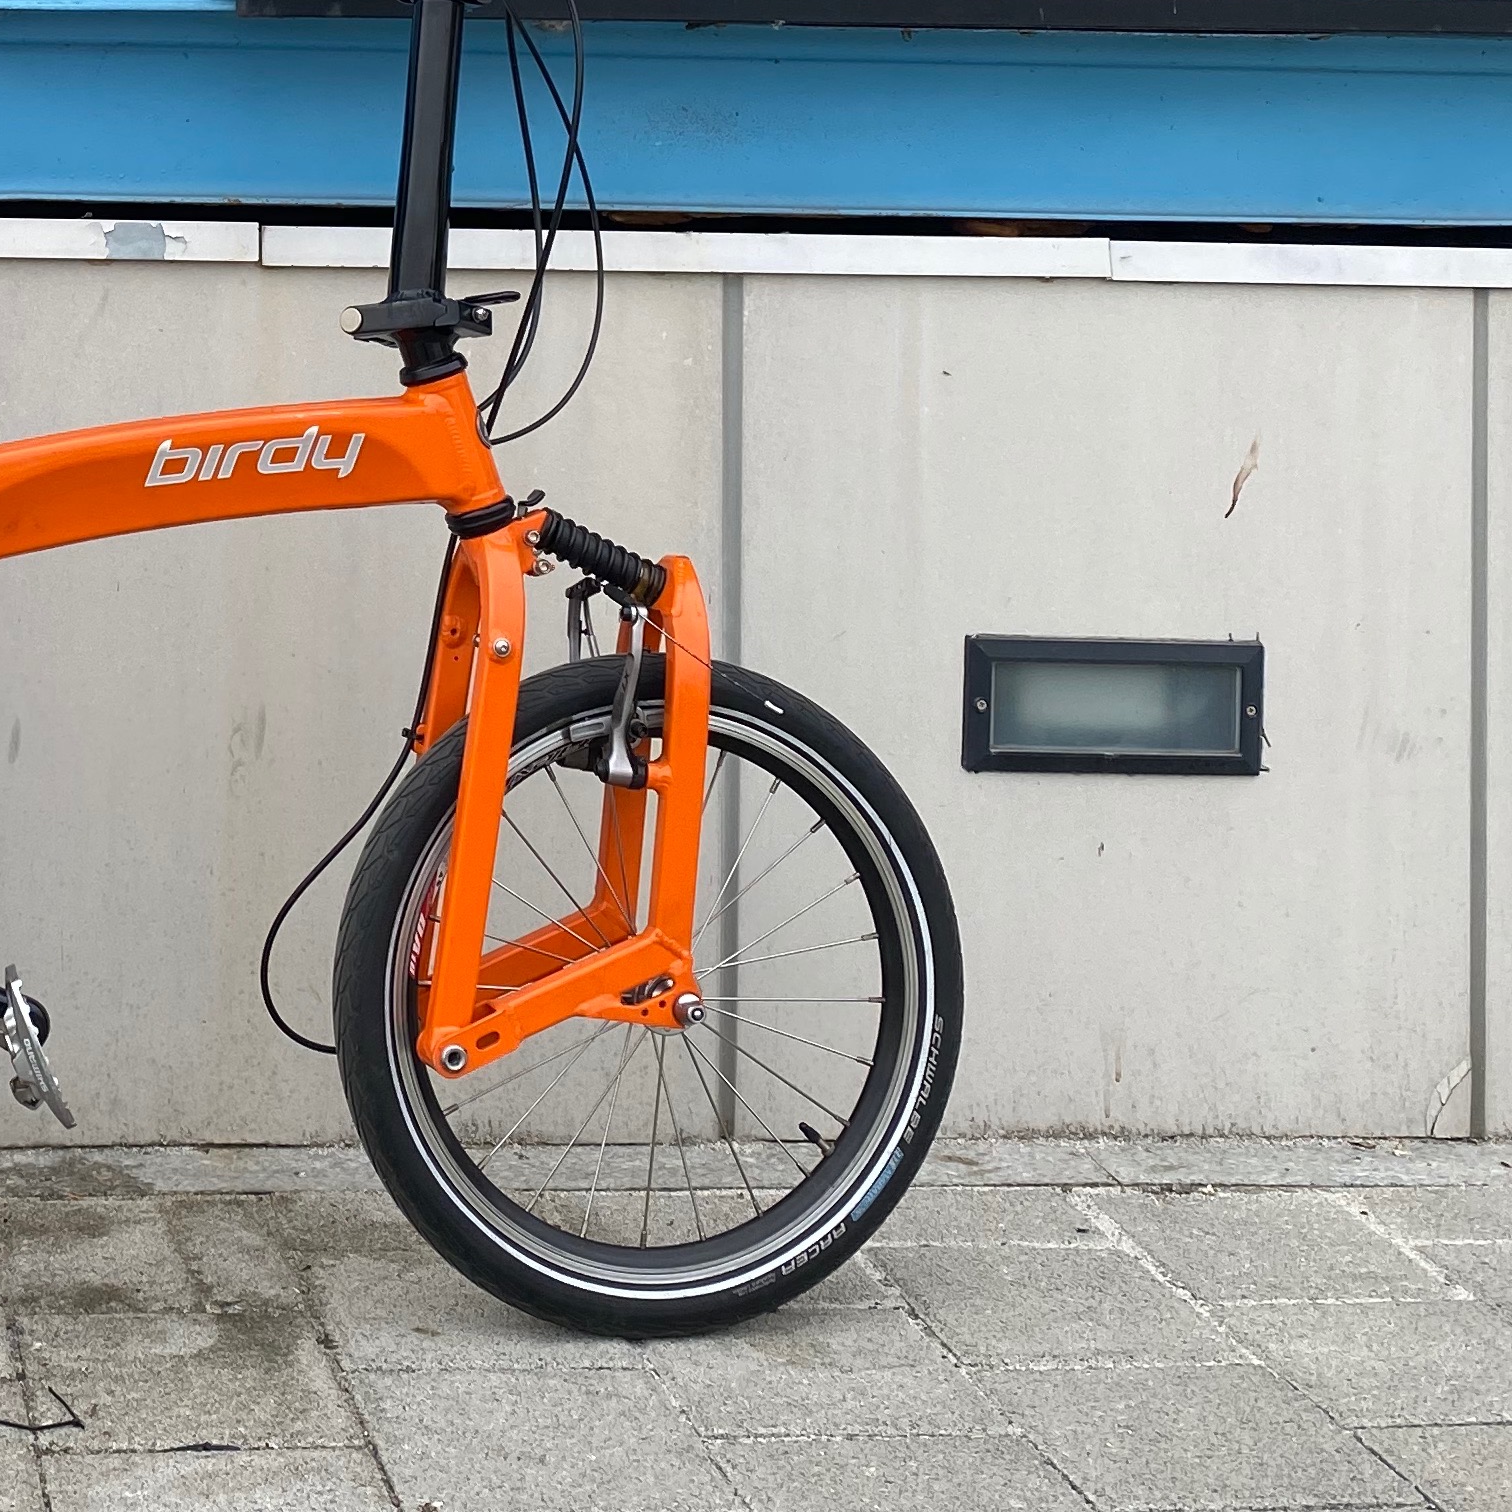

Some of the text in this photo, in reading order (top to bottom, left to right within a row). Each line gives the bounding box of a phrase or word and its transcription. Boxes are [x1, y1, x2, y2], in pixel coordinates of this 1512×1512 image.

[143, 425, 366, 488] birdy
[780, 1013, 944, 1276] SCHWALBE RACER
